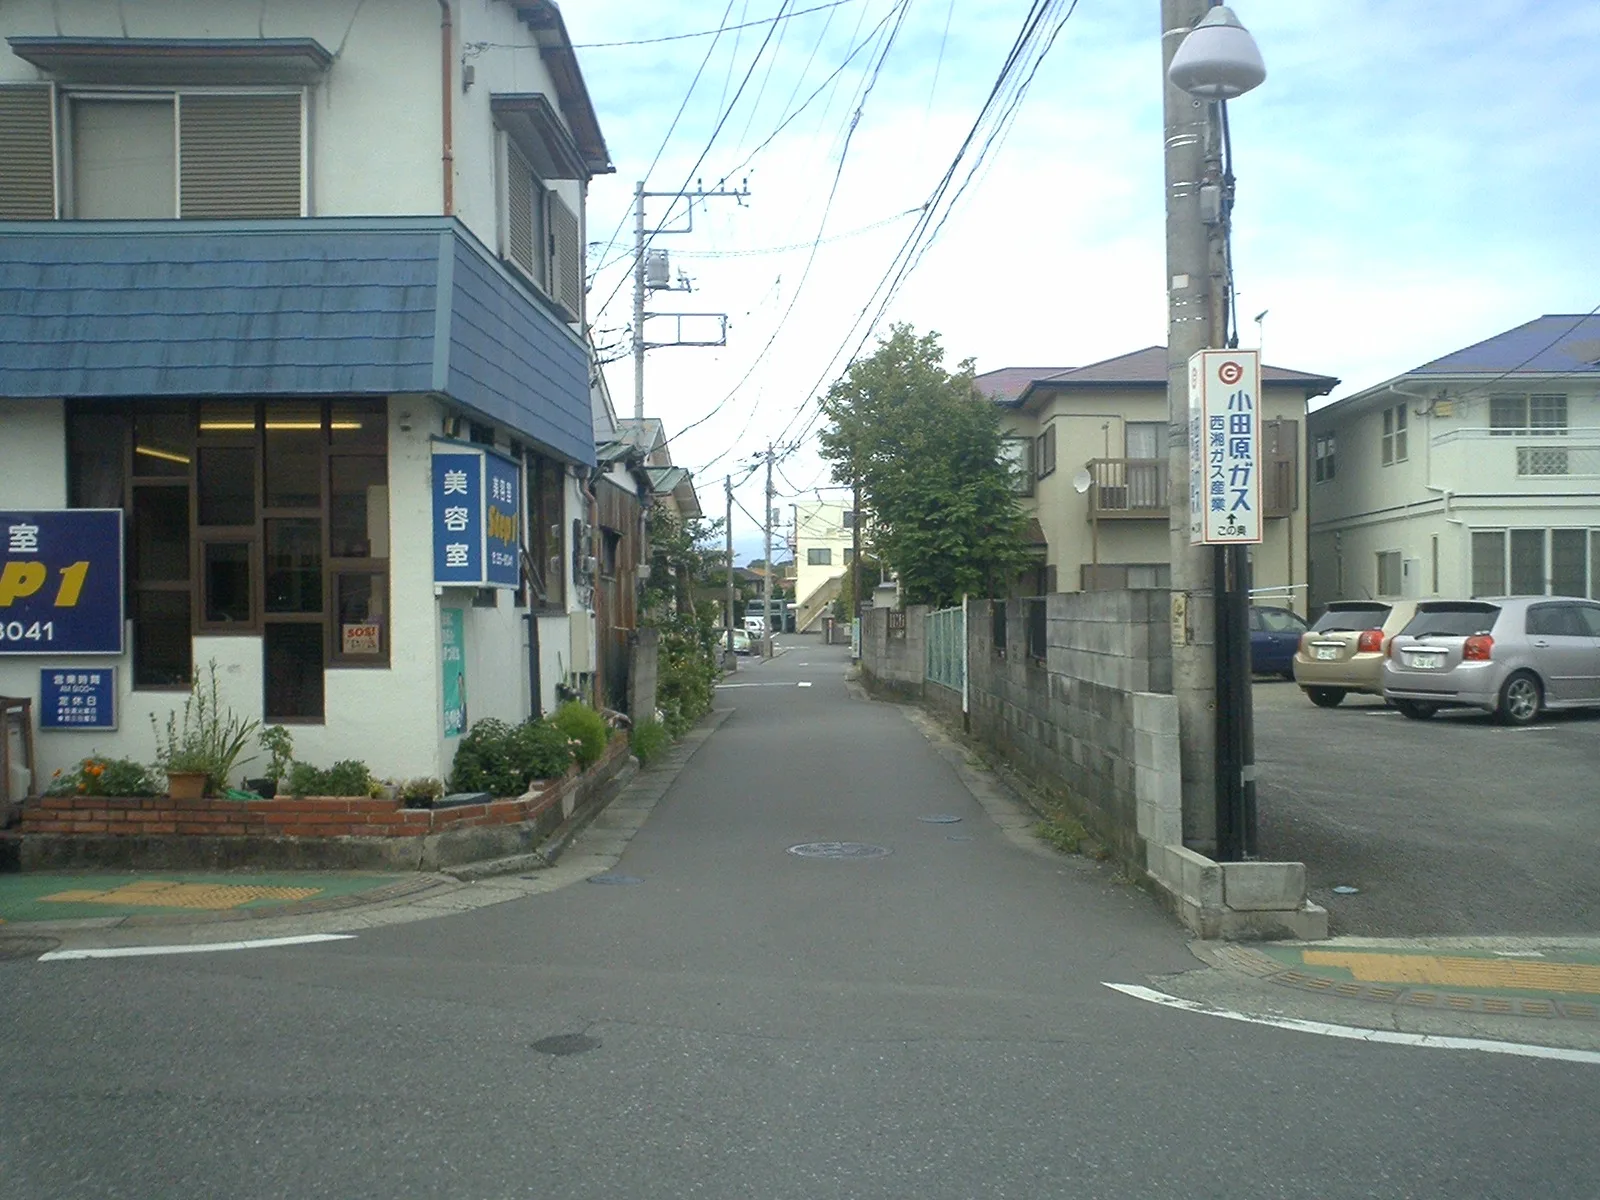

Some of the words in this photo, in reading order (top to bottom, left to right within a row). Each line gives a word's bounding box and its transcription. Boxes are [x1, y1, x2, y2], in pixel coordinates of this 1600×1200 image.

[1210, 415, 1226, 512] 西湘ガス産業
[1228, 389, 1253, 511] 小田原ガス
[8, 523, 39, 553] 室
[444, 469, 469, 567] 美容室
[1217, 525, 1246, 536] この奥
